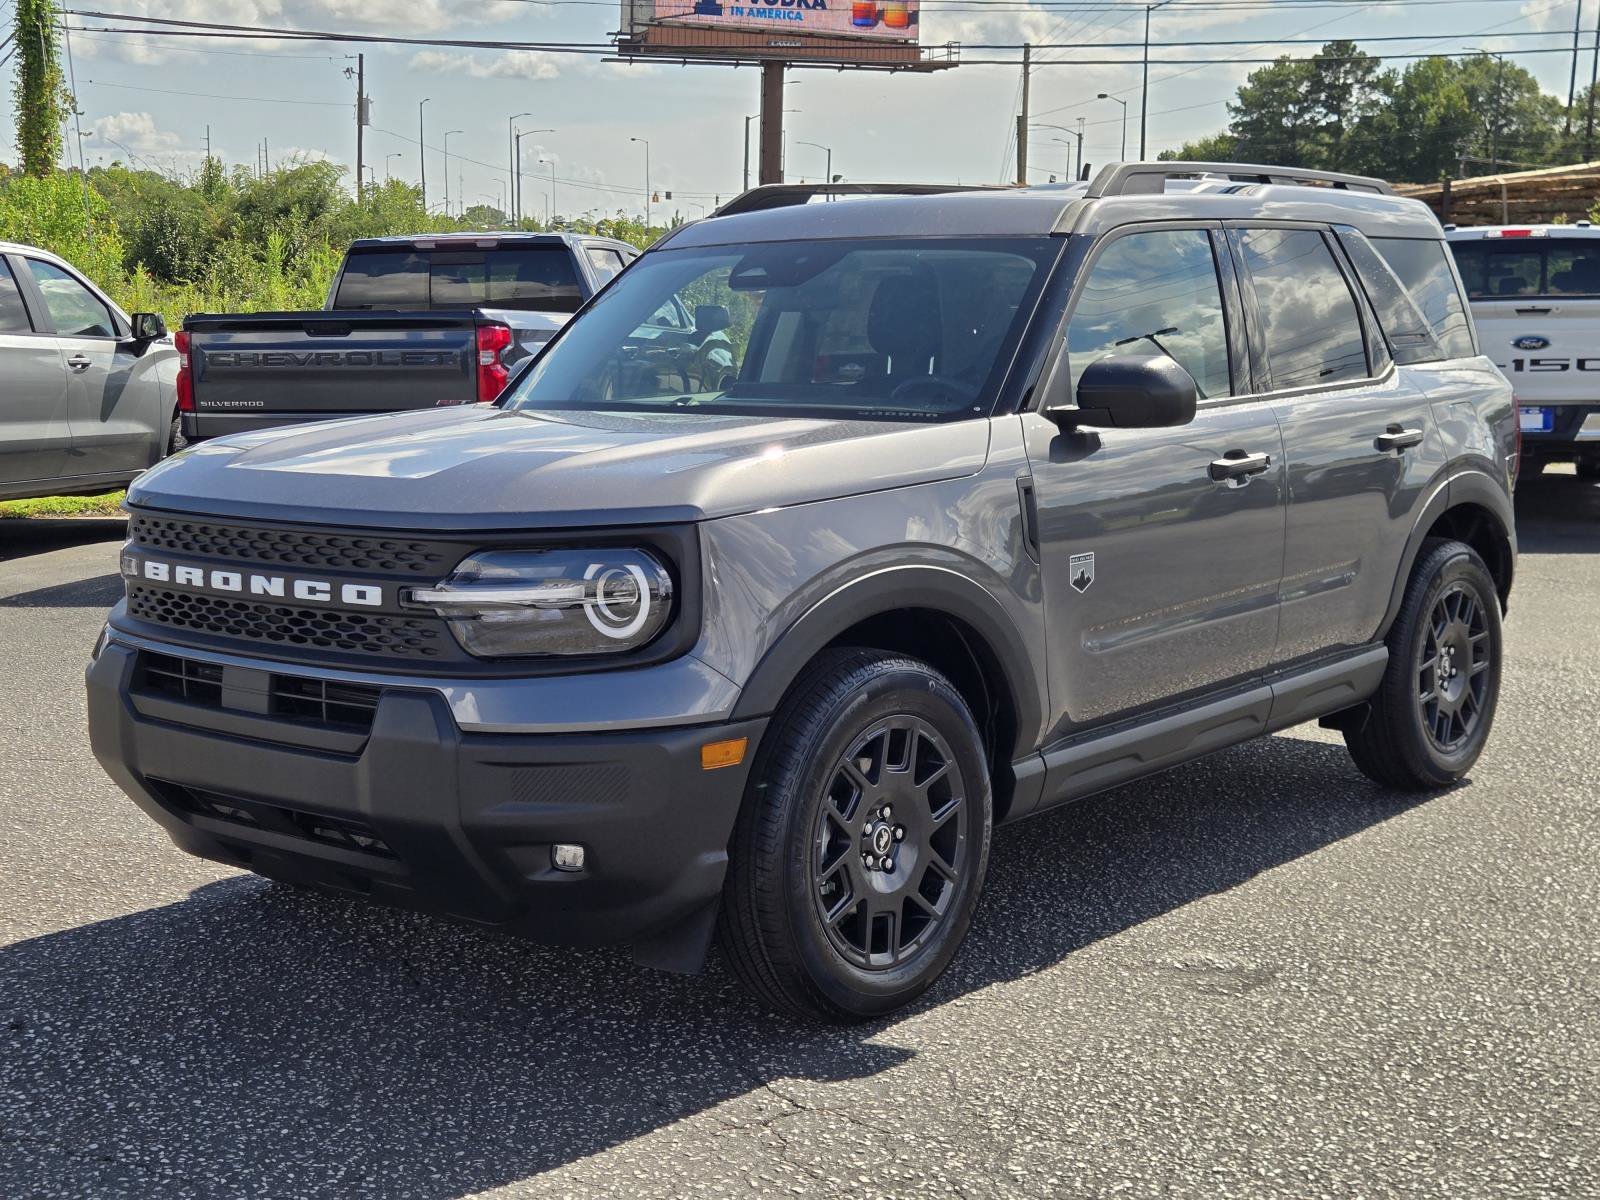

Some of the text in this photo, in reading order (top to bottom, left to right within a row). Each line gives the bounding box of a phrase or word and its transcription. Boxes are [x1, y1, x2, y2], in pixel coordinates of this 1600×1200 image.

[730, 6, 804, 20] IN AMERICA
[207, 351, 455, 367] CHEVROLET
[1496, 358, 1600, 372] -150
[144, 560, 383, 606] BRONCO
